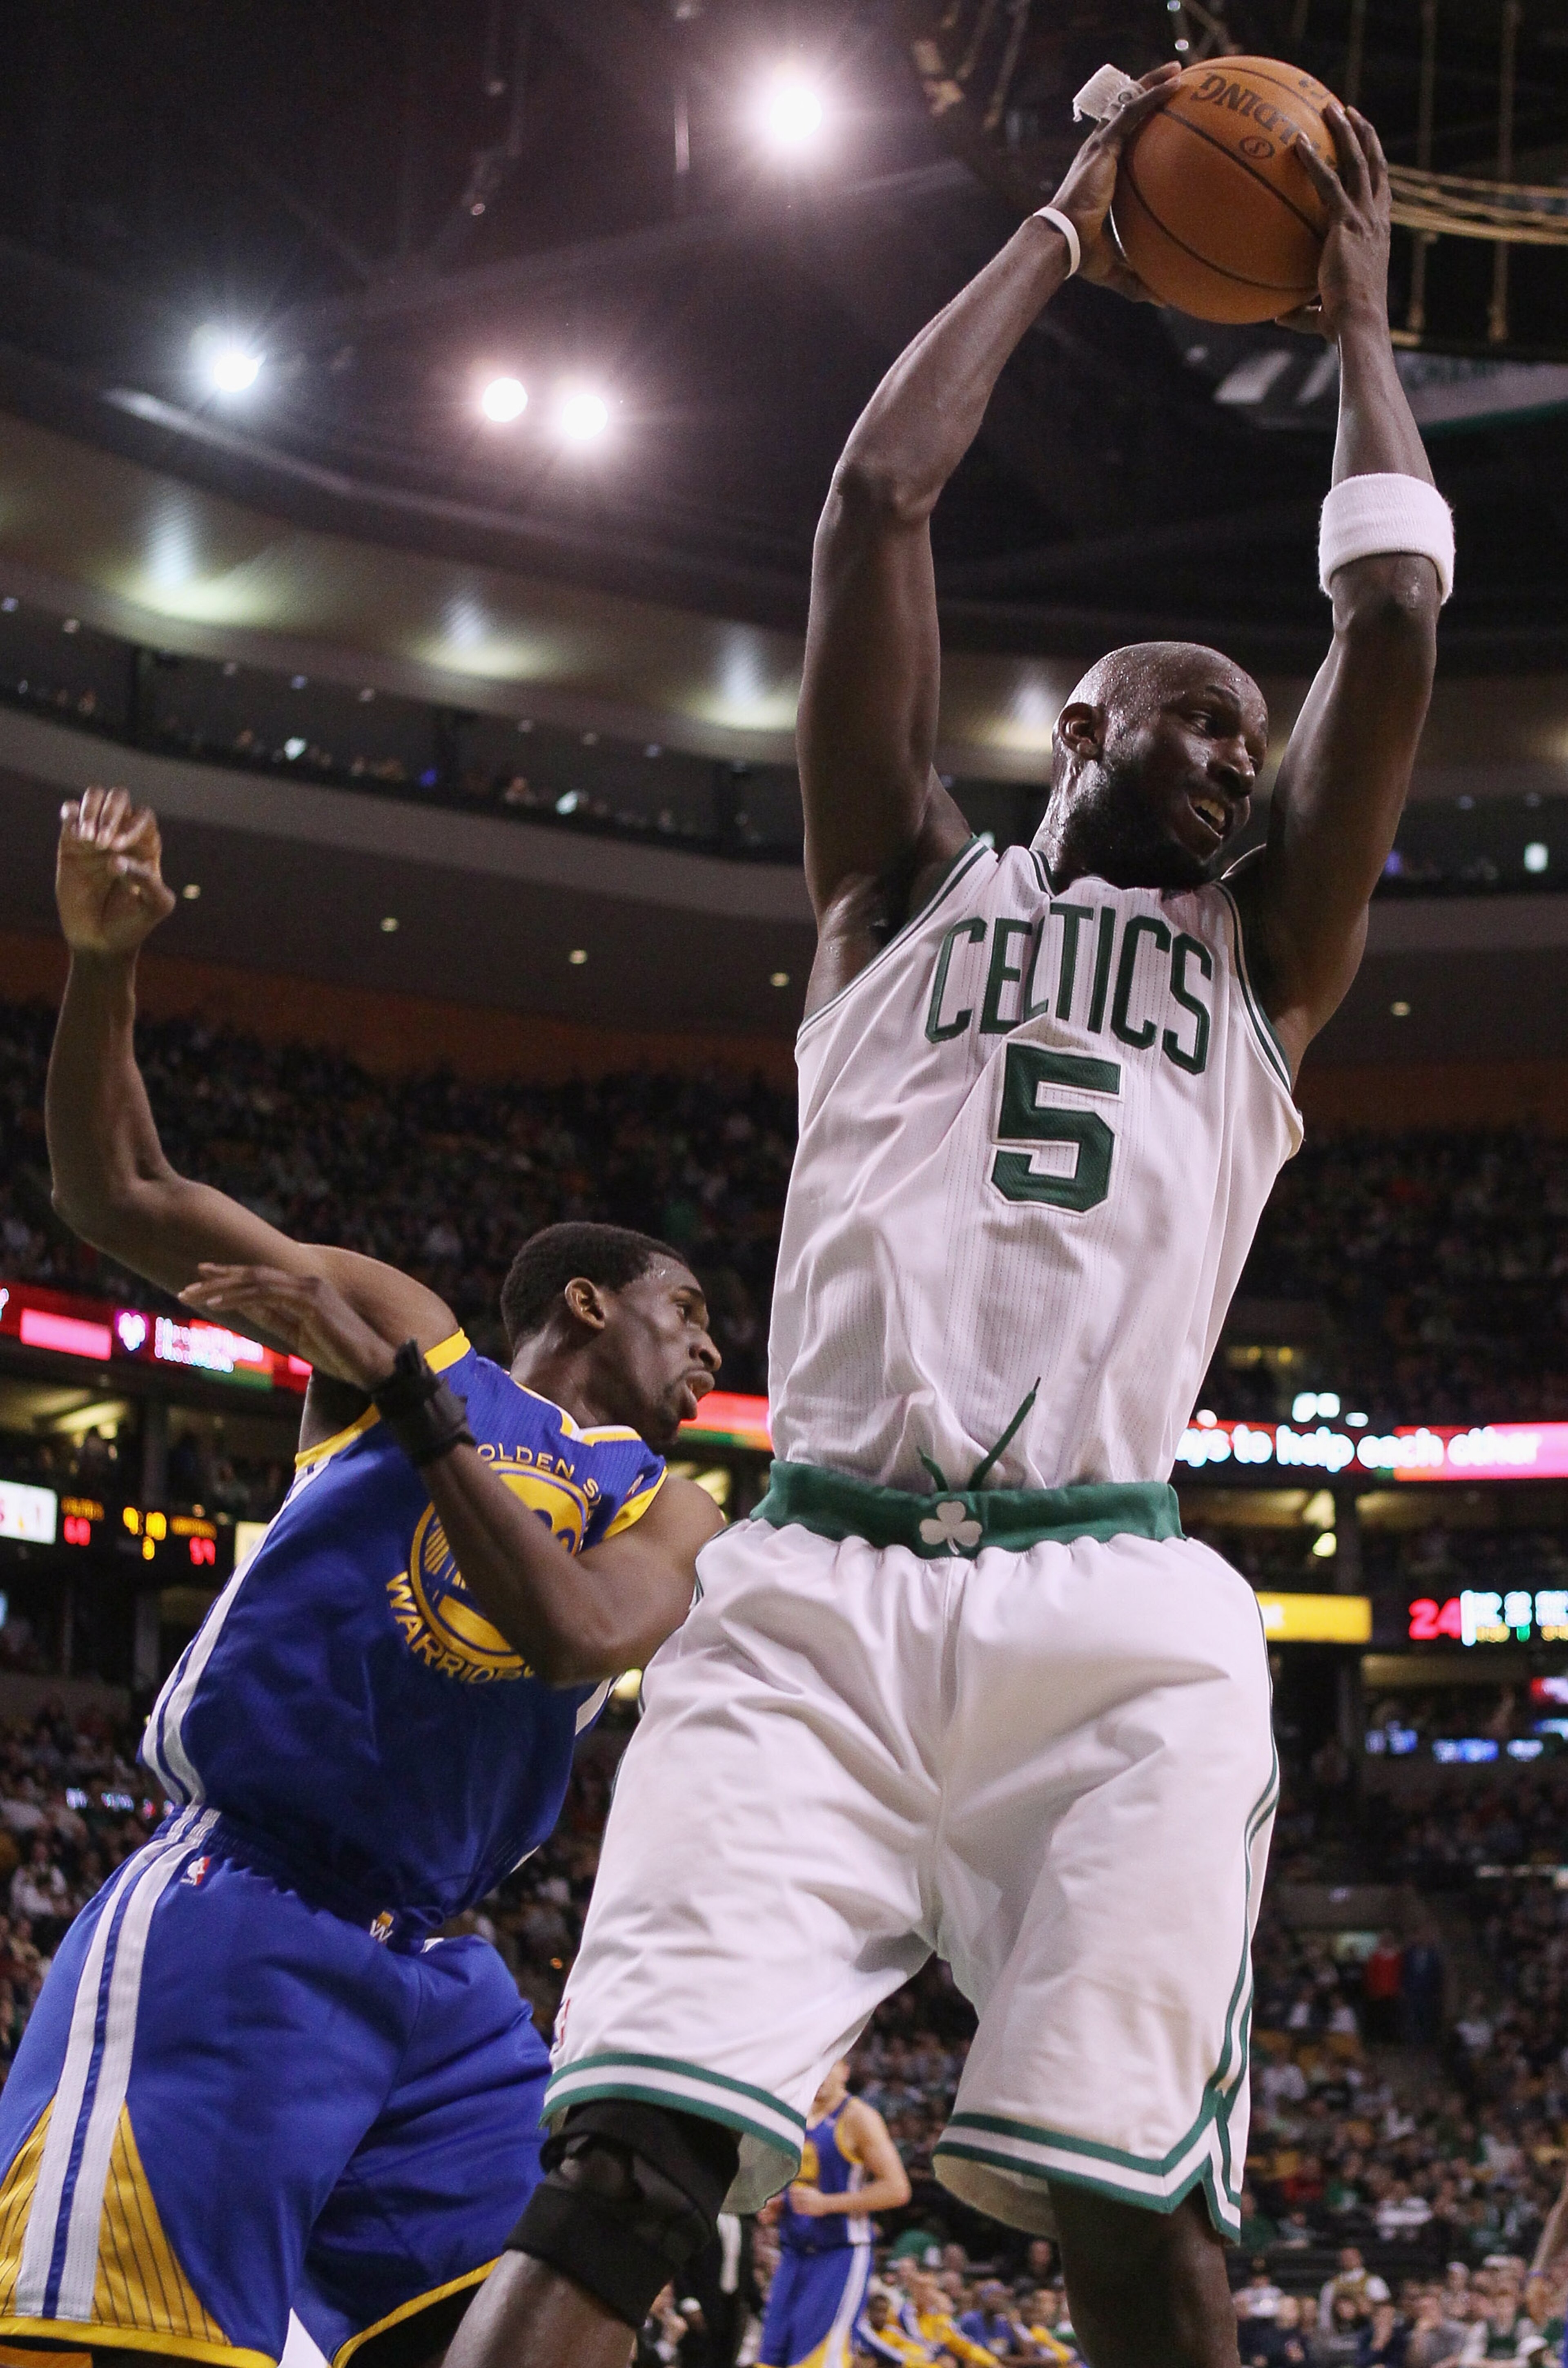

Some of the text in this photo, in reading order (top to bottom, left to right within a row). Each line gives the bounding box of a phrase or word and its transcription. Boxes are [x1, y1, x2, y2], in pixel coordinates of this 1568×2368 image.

[1191, 73, 1316, 149] LDING
[925, 902, 1214, 1075] CELTICS
[990, 1041, 1122, 1215] 5
[477, 1443, 575, 1479] OLDEN
[1232, 1425, 1272, 1463] to
[1276, 1425, 1355, 1472] help
[1357, 1427, 1444, 1468] each
[1448, 1426, 1542, 1466] other
[1409, 1597, 1461, 1640] 24
